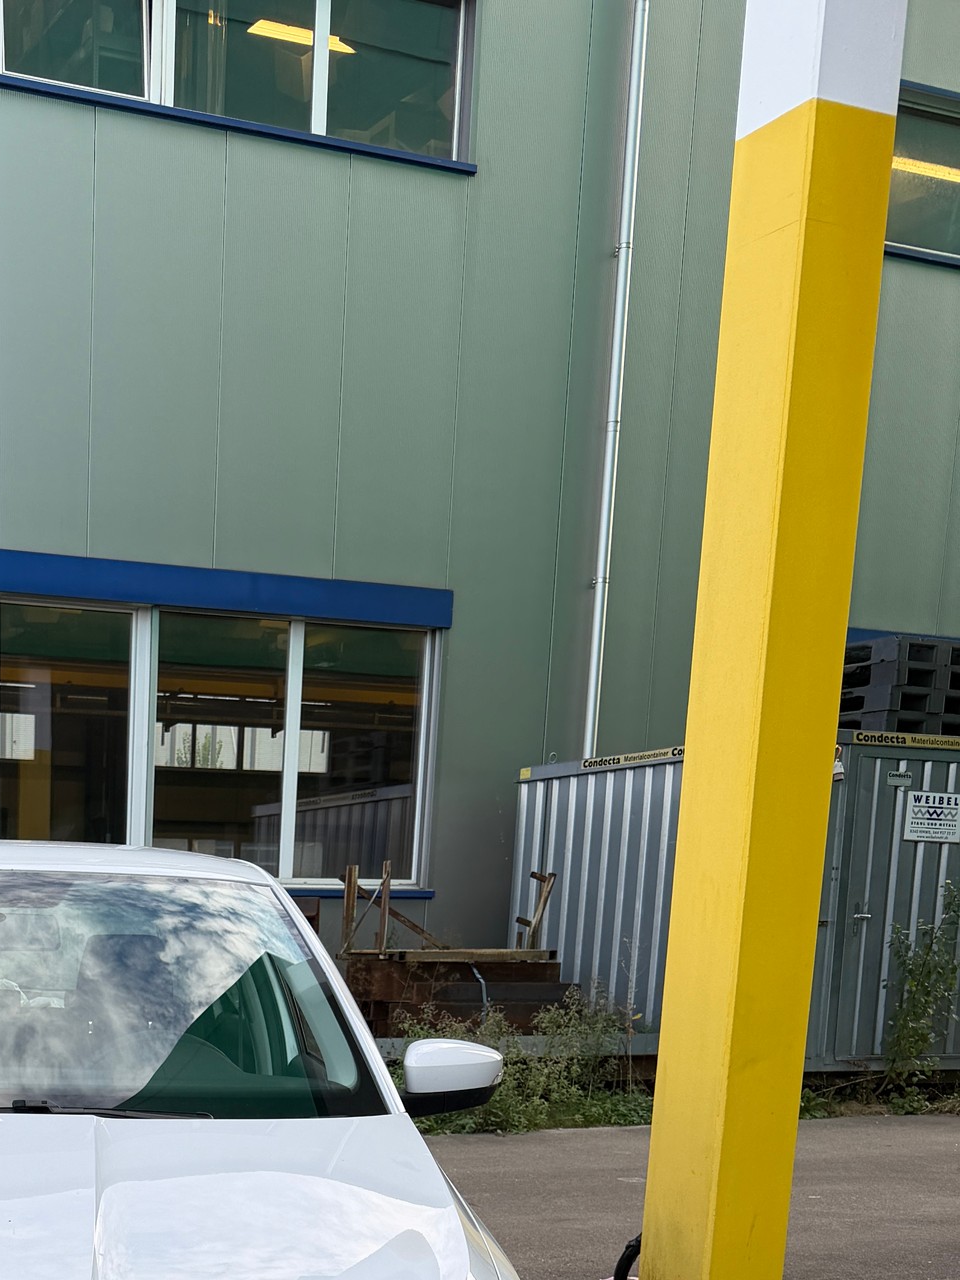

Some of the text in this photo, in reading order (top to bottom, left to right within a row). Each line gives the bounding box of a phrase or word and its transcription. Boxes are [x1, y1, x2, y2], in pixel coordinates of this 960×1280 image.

[856, 732, 960, 747] Condecta Materialcontain
[583, 757, 621, 768] Condecta
[623, 750, 669, 763] Materialcontainer
[913, 794, 959, 807] WEIBEL
